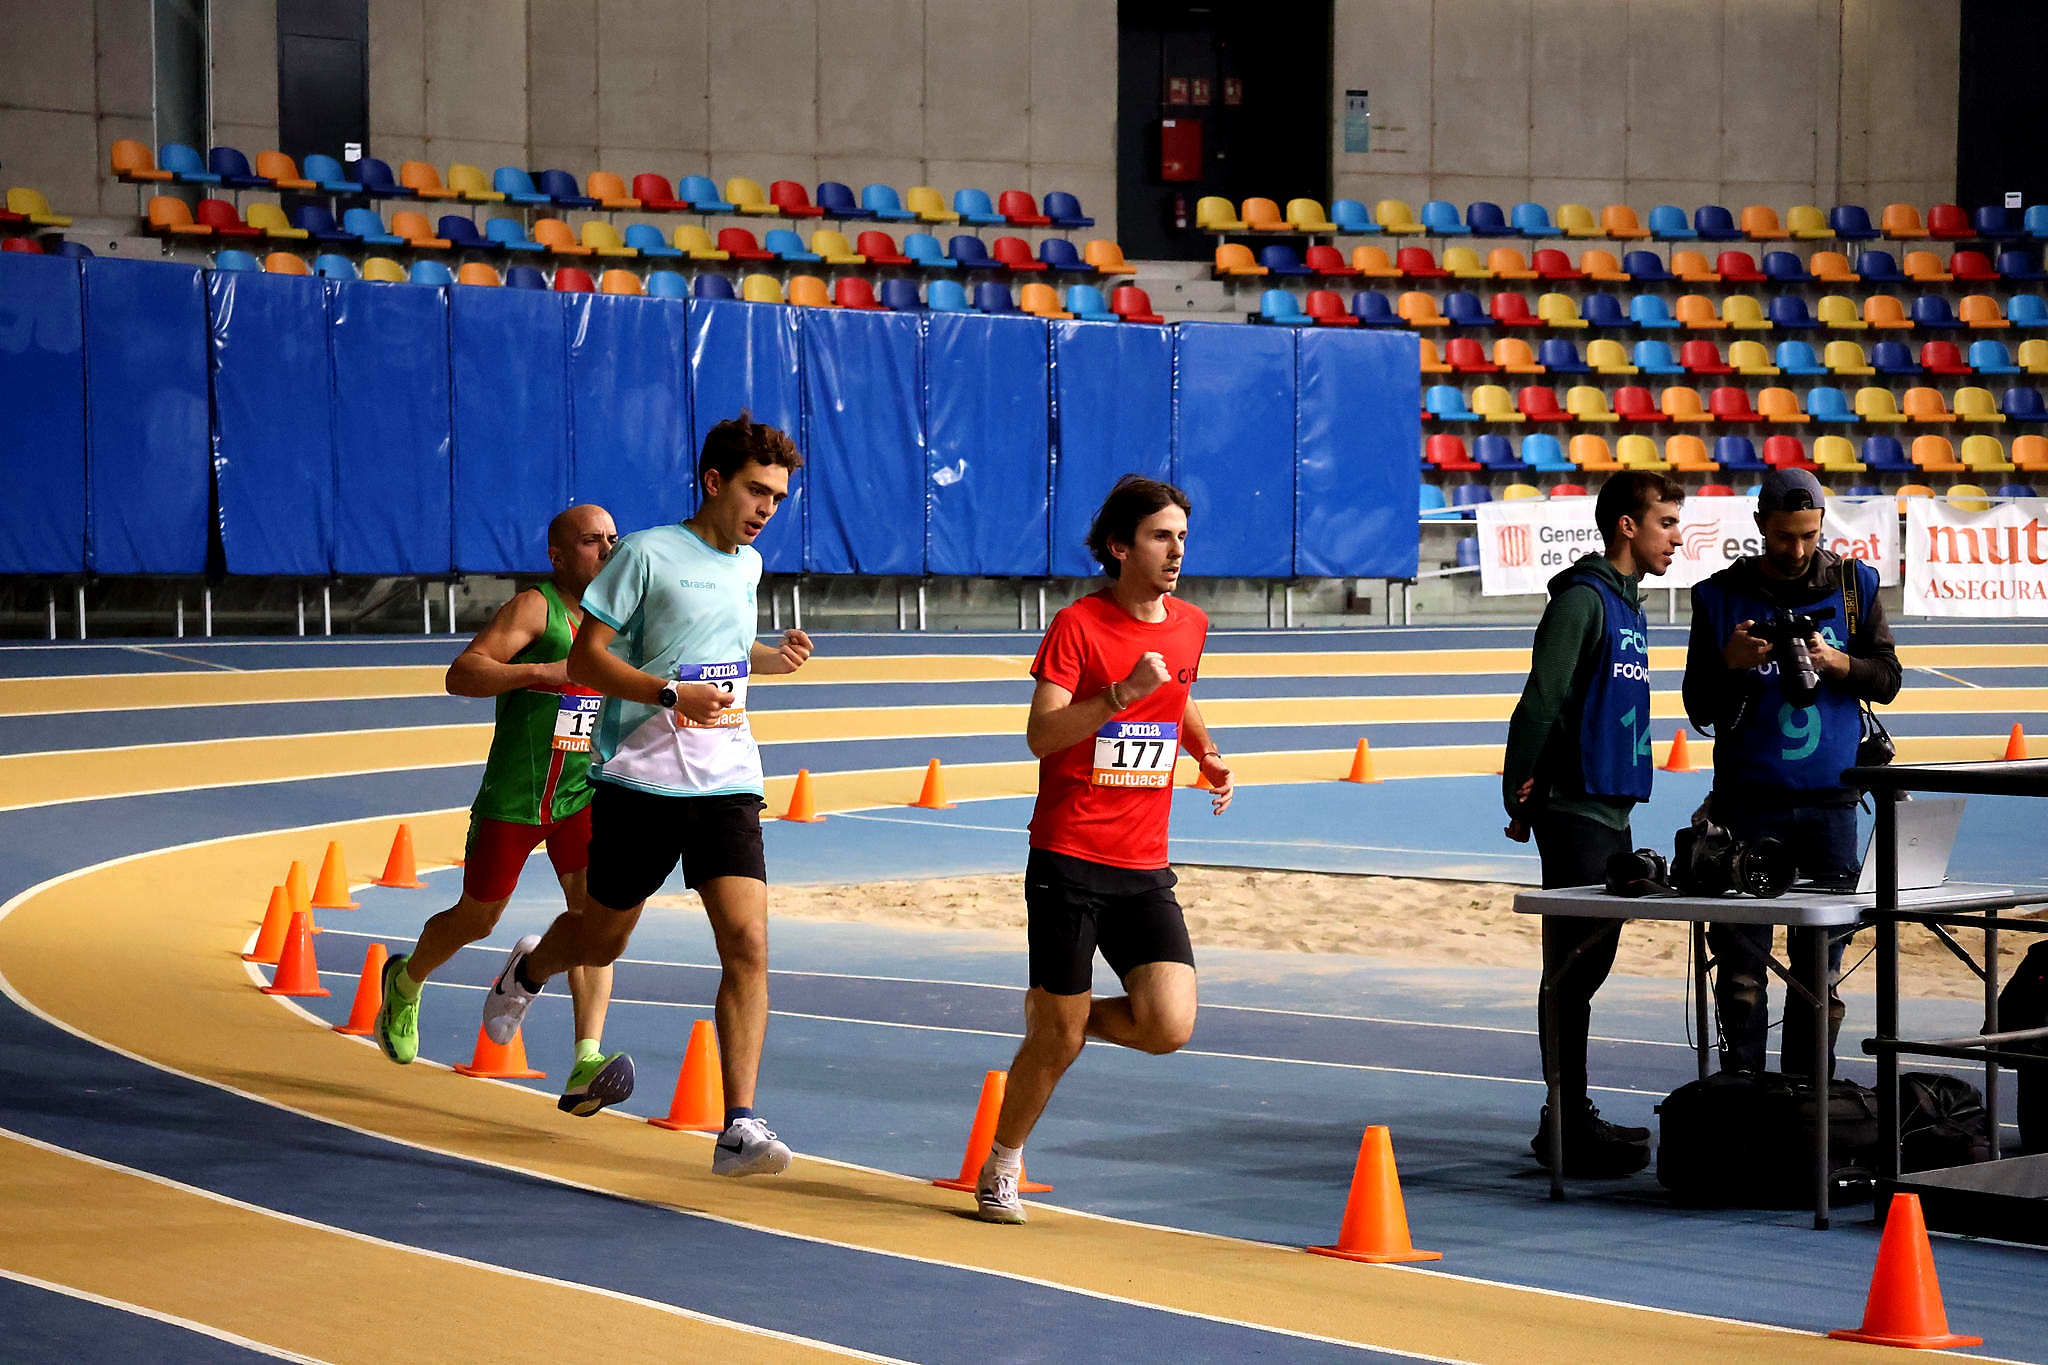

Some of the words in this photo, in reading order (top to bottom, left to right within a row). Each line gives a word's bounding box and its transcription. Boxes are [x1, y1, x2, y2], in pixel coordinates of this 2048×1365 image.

[1540, 526, 1603, 543] Genera
[1541, 549, 1562, 566] de
[1924, 578, 2048, 600] ASSEGURA
[569, 713, 596, 737] 13
[1777, 701, 1822, 760] 9
[1111, 740, 1164, 769] 177
